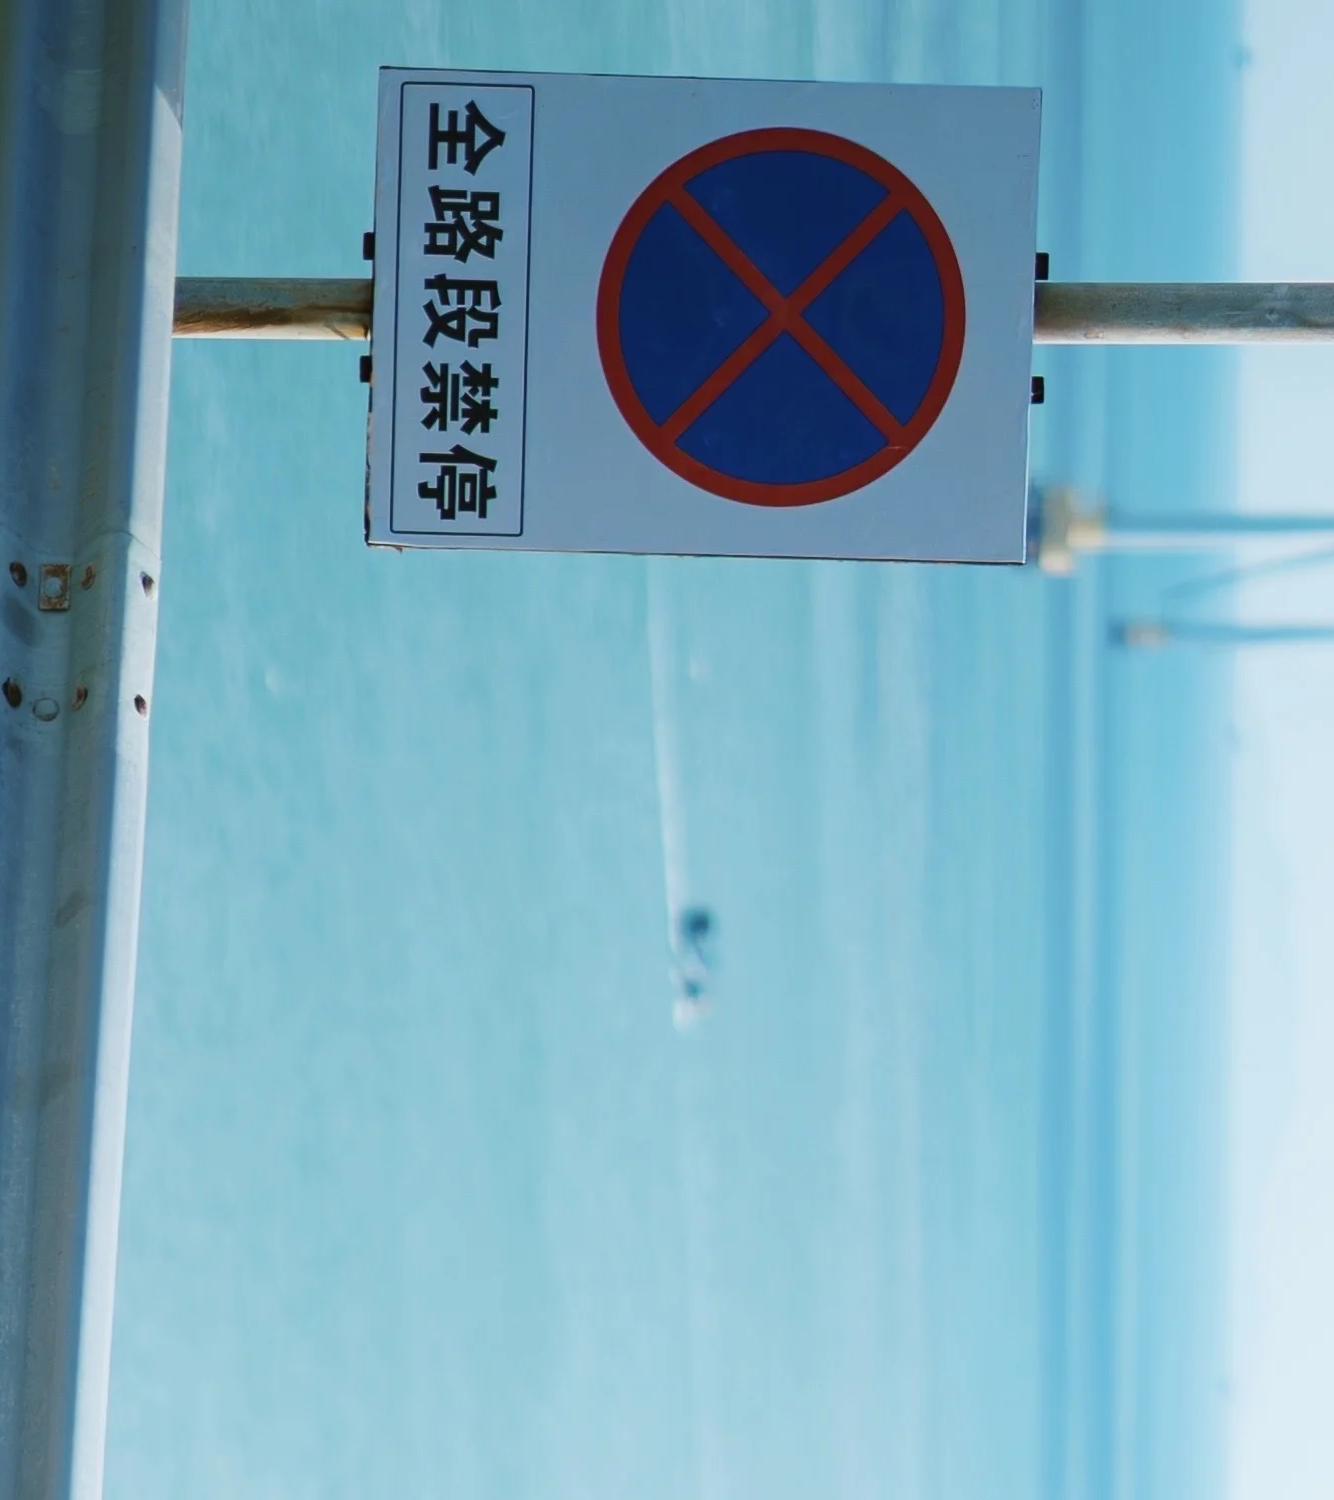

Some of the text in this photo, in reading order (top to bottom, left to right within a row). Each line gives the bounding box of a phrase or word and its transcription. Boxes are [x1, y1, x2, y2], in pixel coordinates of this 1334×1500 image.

[418, 99, 506, 520] 全路段禁停
